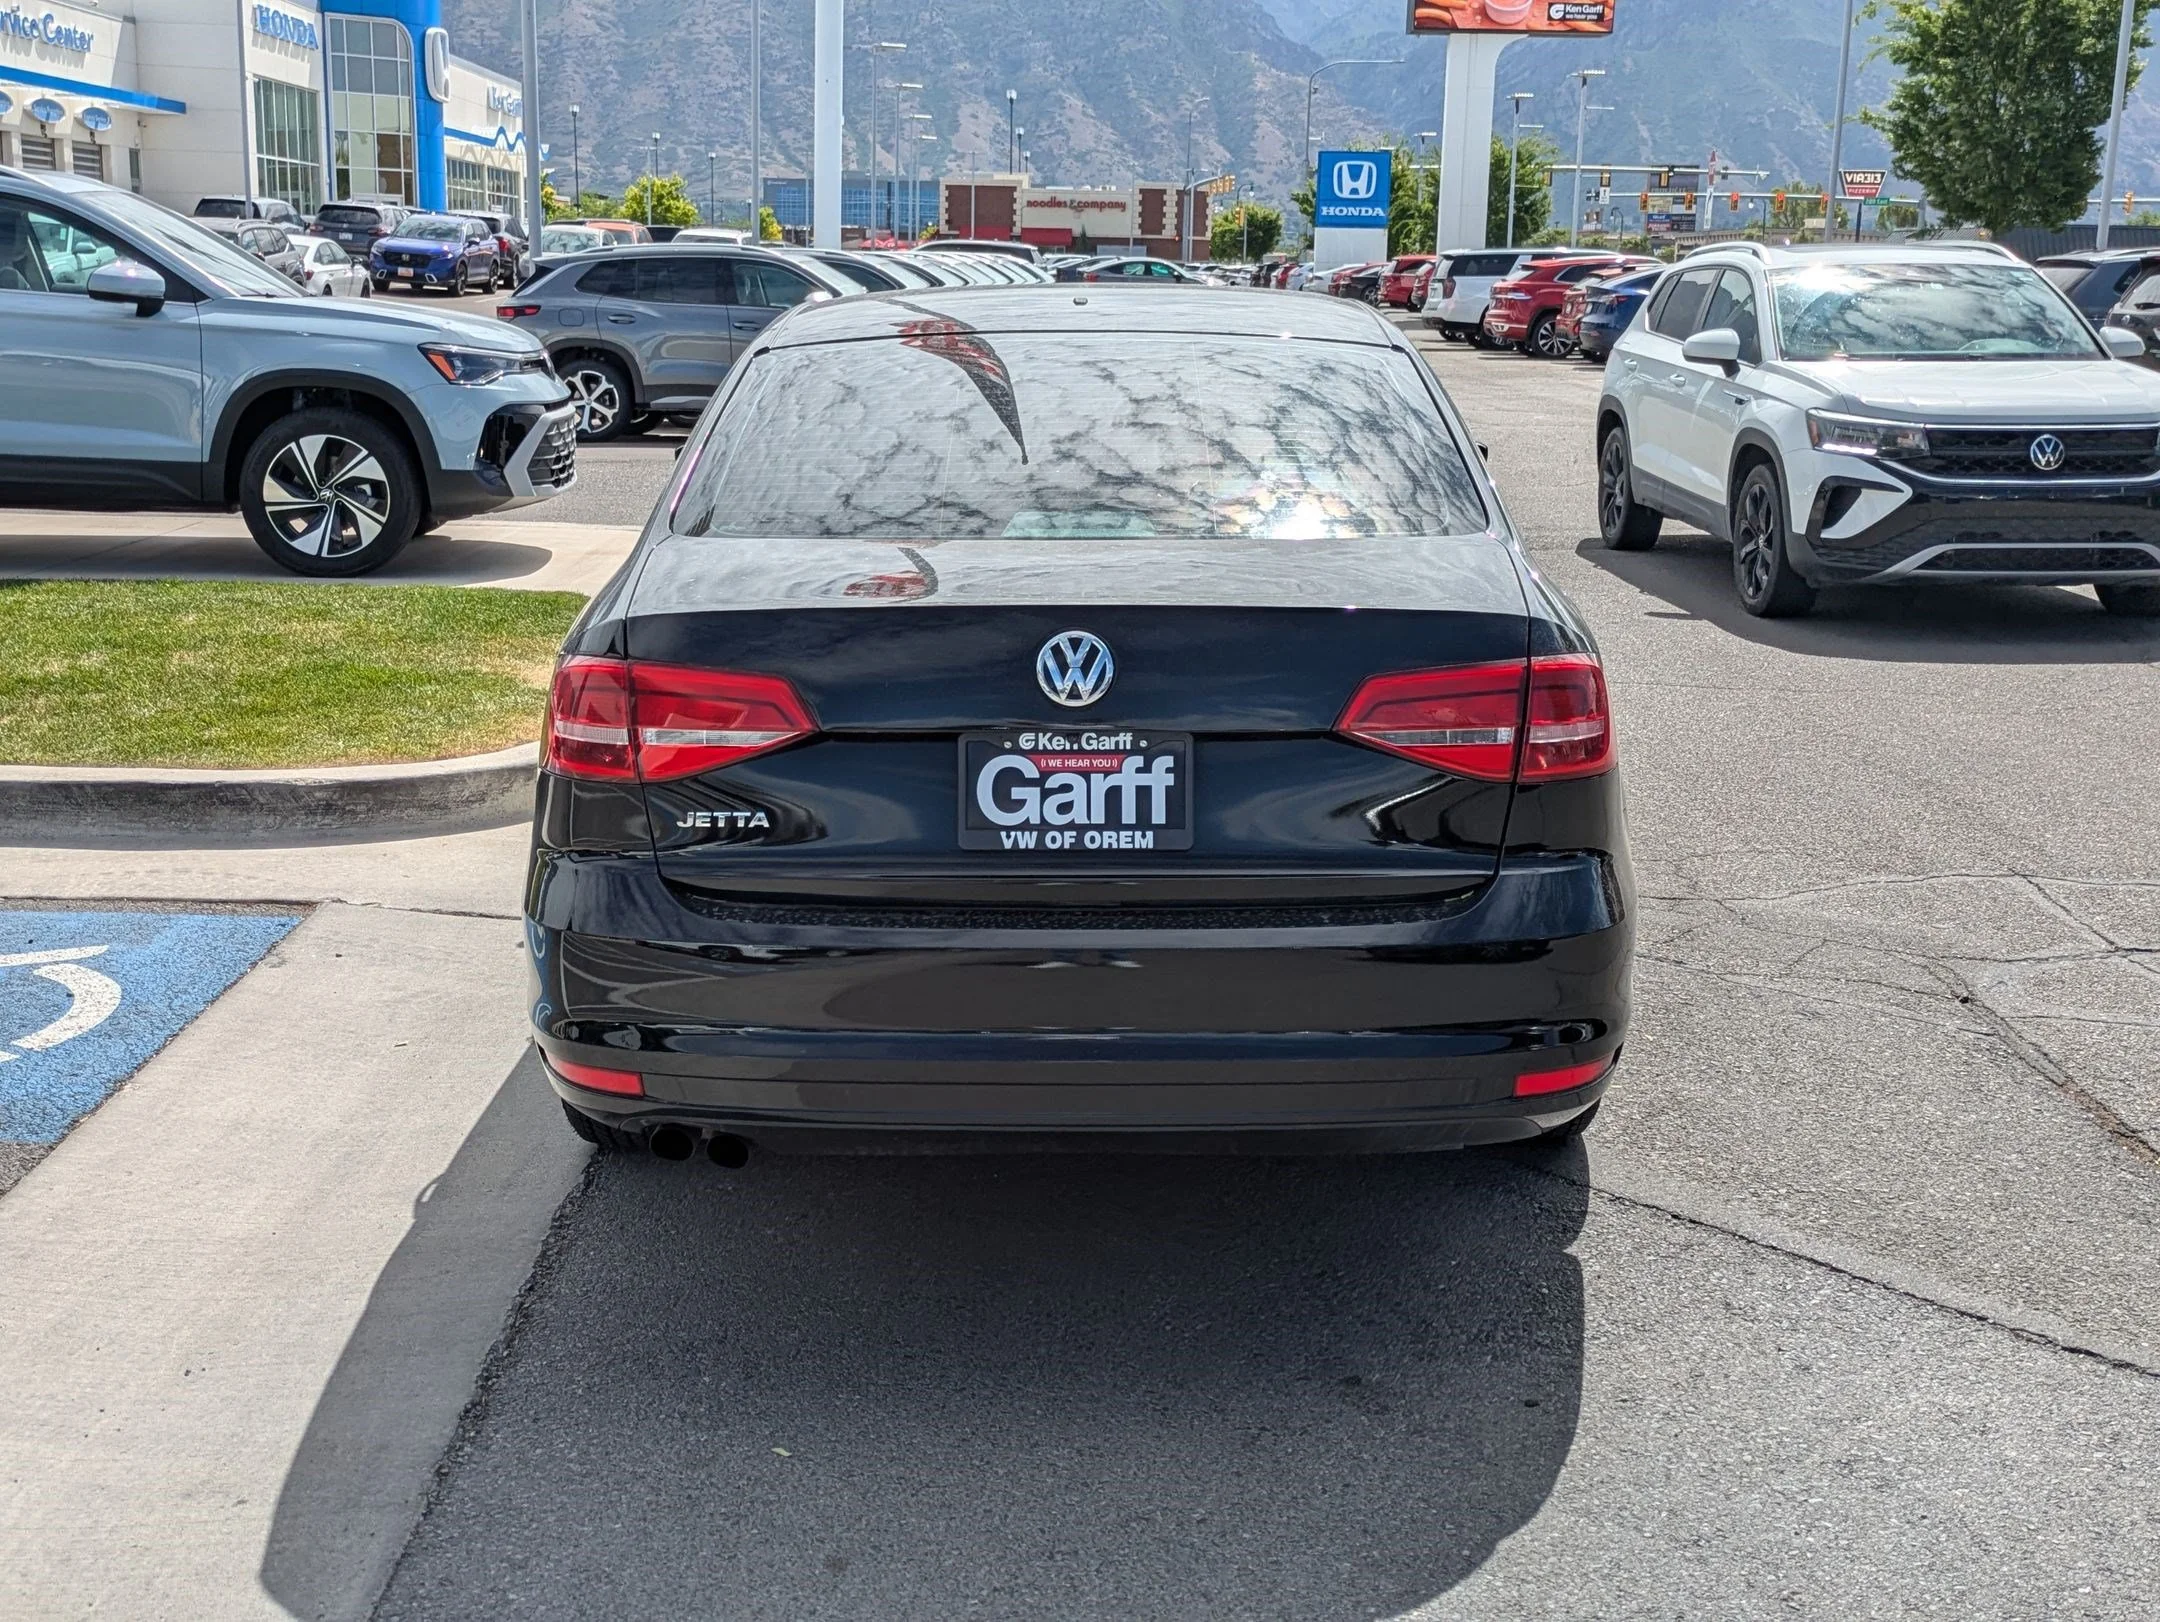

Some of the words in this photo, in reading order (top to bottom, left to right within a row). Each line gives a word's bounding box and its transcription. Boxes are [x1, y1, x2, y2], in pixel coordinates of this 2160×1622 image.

[1565, 4, 1581, 13] Ken
[1583, 4, 1603, 13] Garff
[43, 13, 94, 52] Center
[254, 4, 319, 49] HONDA
[1026, 196, 1068, 208] noodles
[1077, 199, 1126, 213] company
[1321, 206, 1385, 217] HONDA
[1081, 732, 1133, 750] Garff
[1048, 758, 1063, 768] WE
[1065, 758, 1091, 768] HEAR
[1092, 758, 1112, 768] YOU
[976, 754, 1175, 826] Garff
[676, 811, 770, 828] JETTA
[1000, 830, 1038, 849] VW
[1045, 830, 1078, 849] OF
[1084, 830, 1154, 849] OREM
